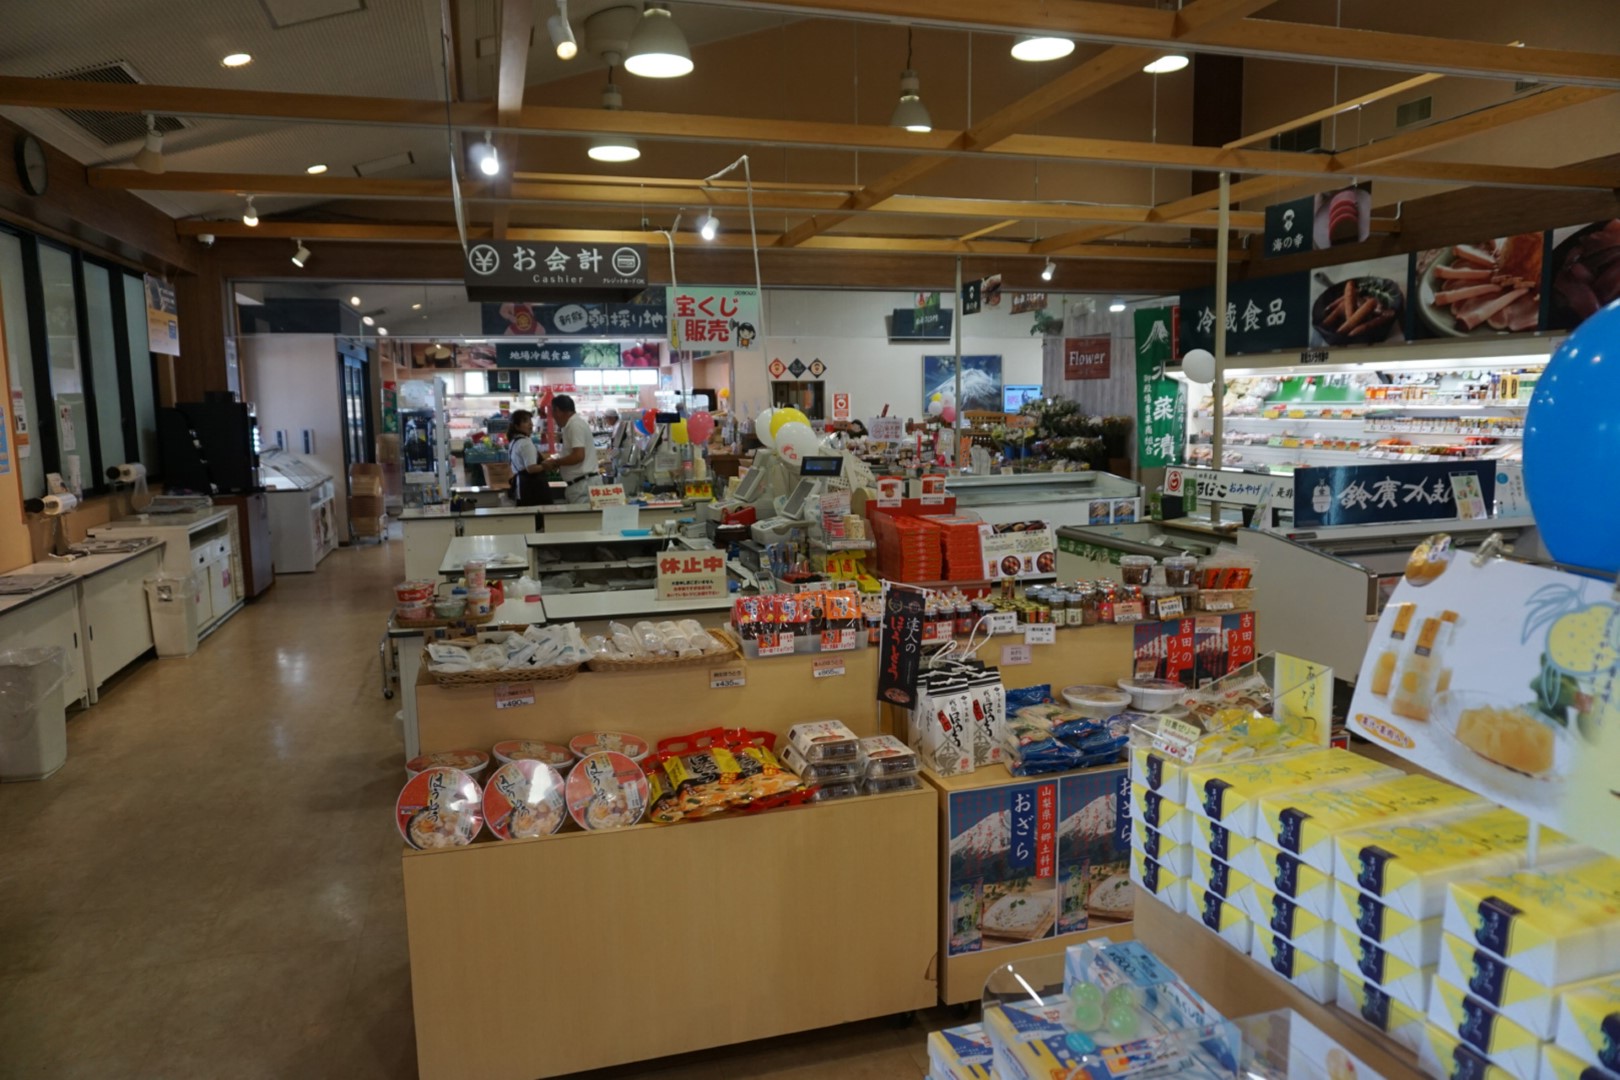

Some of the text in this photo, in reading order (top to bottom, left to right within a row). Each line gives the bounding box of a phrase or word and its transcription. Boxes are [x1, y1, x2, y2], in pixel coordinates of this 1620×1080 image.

[512, 246, 603, 274] お会計
[532, 274, 584, 284] Cashier
[558, 312, 585, 326] 新鮮
[588, 308, 666, 329] 朝採り地
[674, 294, 739, 318] 宝くじ
[1196, 298, 1286, 334] 冷蔵食品
[684, 318, 730, 342] 販売
[509, 350, 572, 362] 地場冷蔵食品
[1069, 350, 1106, 366] Flower
[591, 487, 622, 496] 休止中
[1337, 476, 1453, 510] 鈴廣かま
[660, 556, 723, 574] 休止中
[904, 617, 920, 654] 達人の
[1182, 620, 1192, 662] 吉田の
[1242, 614, 1252, 656] 吉田の
[1168, 638, 1180, 678] うどん
[1228, 632, 1240, 672] うどん
[426, 772, 446, 822] ほうとう
[1014, 793, 1034, 862] おざら
[1040, 786, 1052, 876] 山梨県の郷土料理
